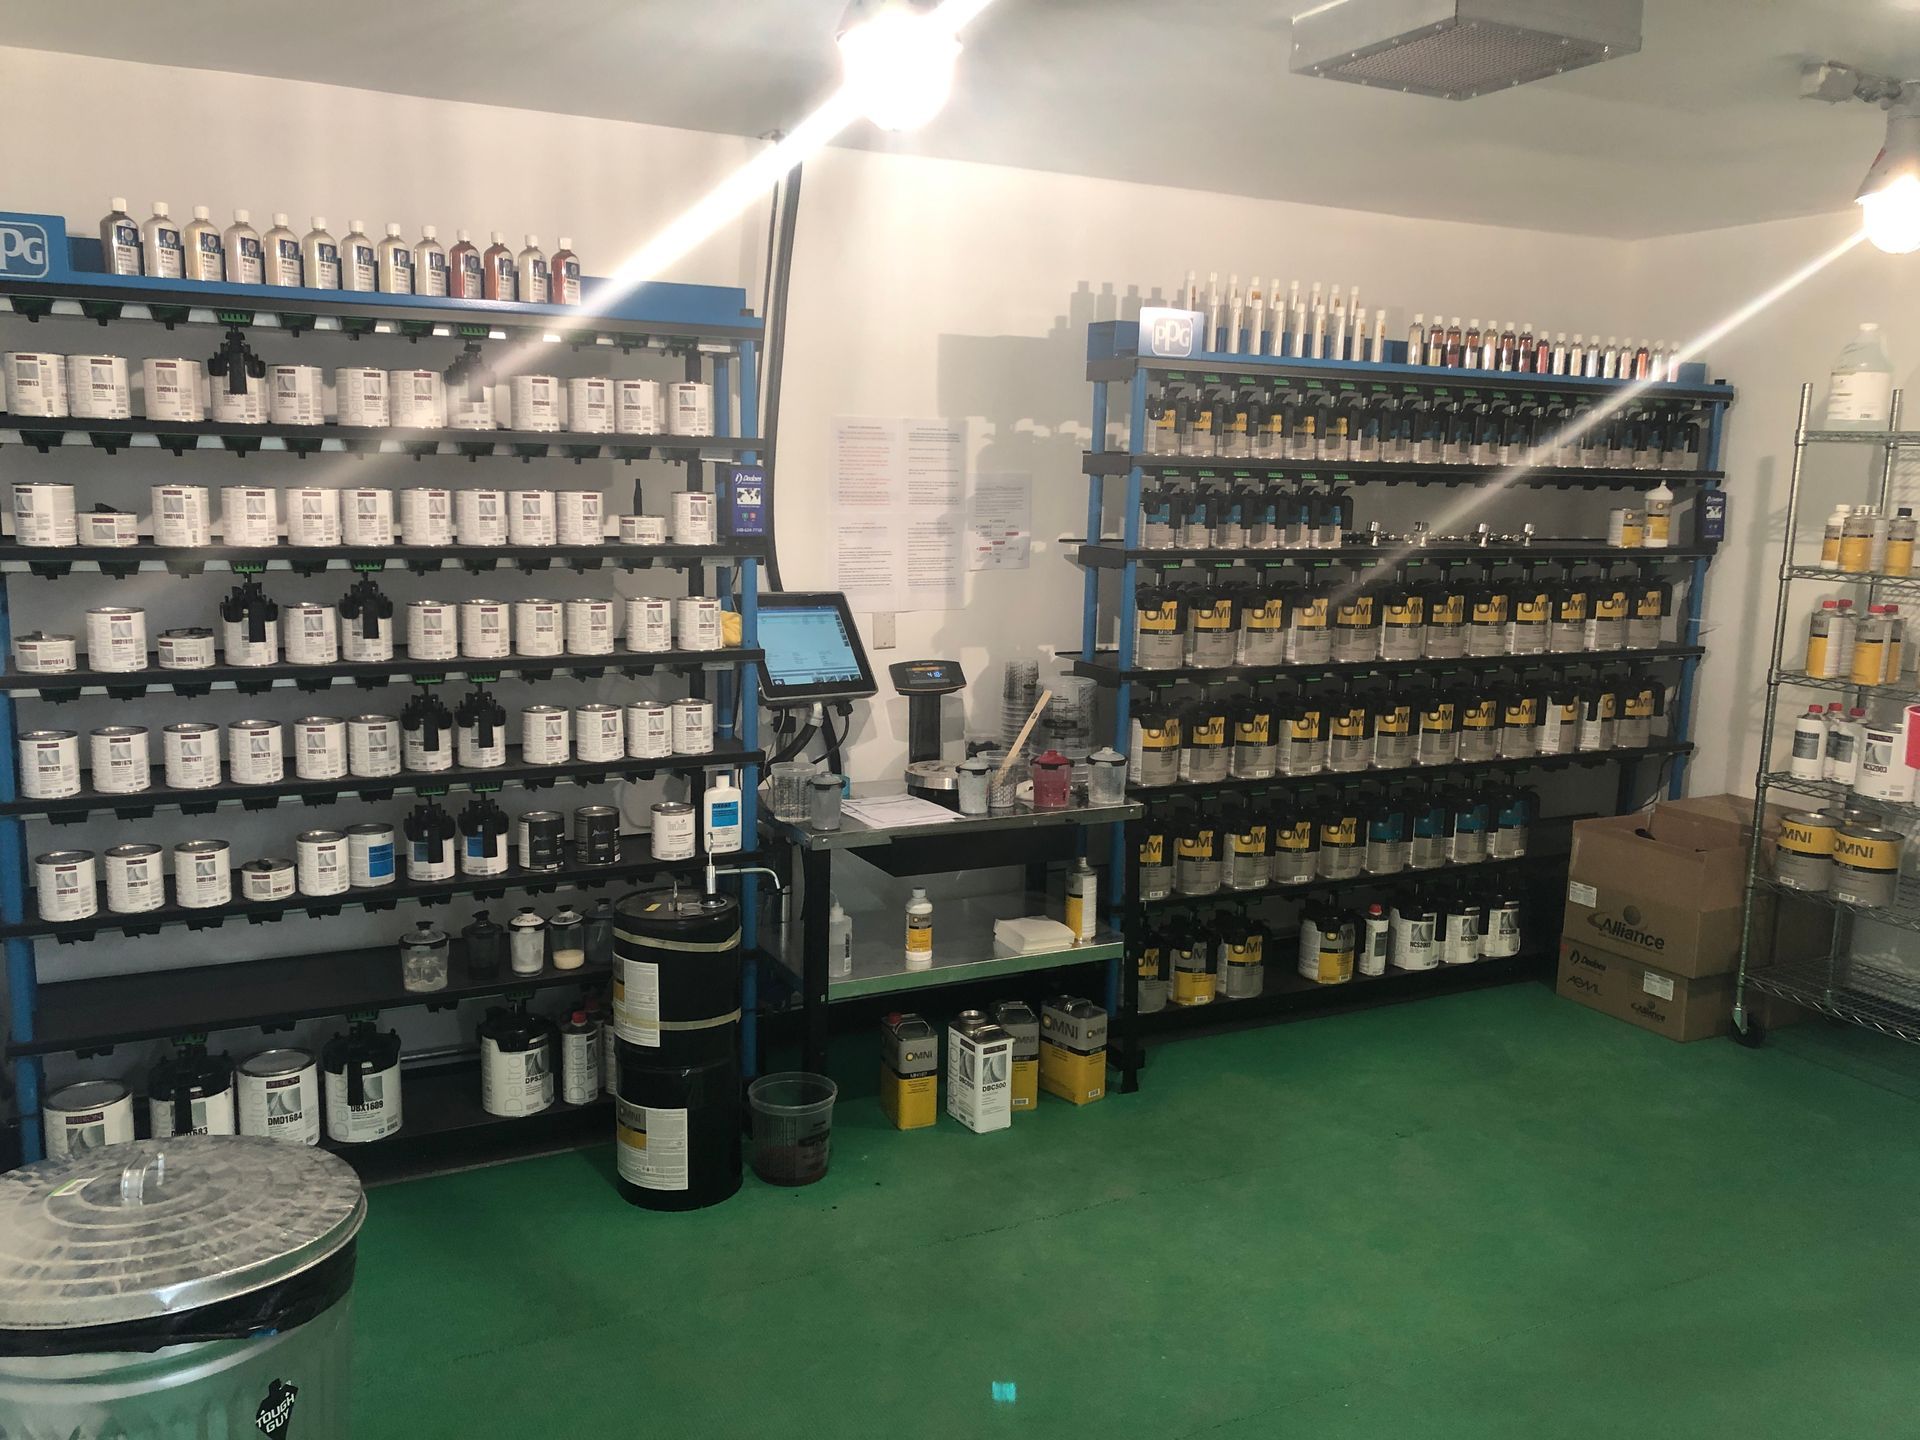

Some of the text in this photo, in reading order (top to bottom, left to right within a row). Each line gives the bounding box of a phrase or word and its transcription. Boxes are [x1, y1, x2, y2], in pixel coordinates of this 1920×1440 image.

[1155, 320, 1190, 352] PPG
[1779, 824, 1813, 844] MNI
[1600, 918, 1665, 950] Alliance
[1041, 1013, 1078, 1039] OMNI
[905, 1050, 933, 1062] OMNI
[504, 1055, 522, 1112] Deltro
[982, 1081, 1007, 1093] DBC500
[267, 1112, 303, 1126] DMD1684
[332, 1078, 349, 1141] Deltro
[256, 1393, 295, 1428] TOUGH
[265, 1408, 289, 1433] GUY
